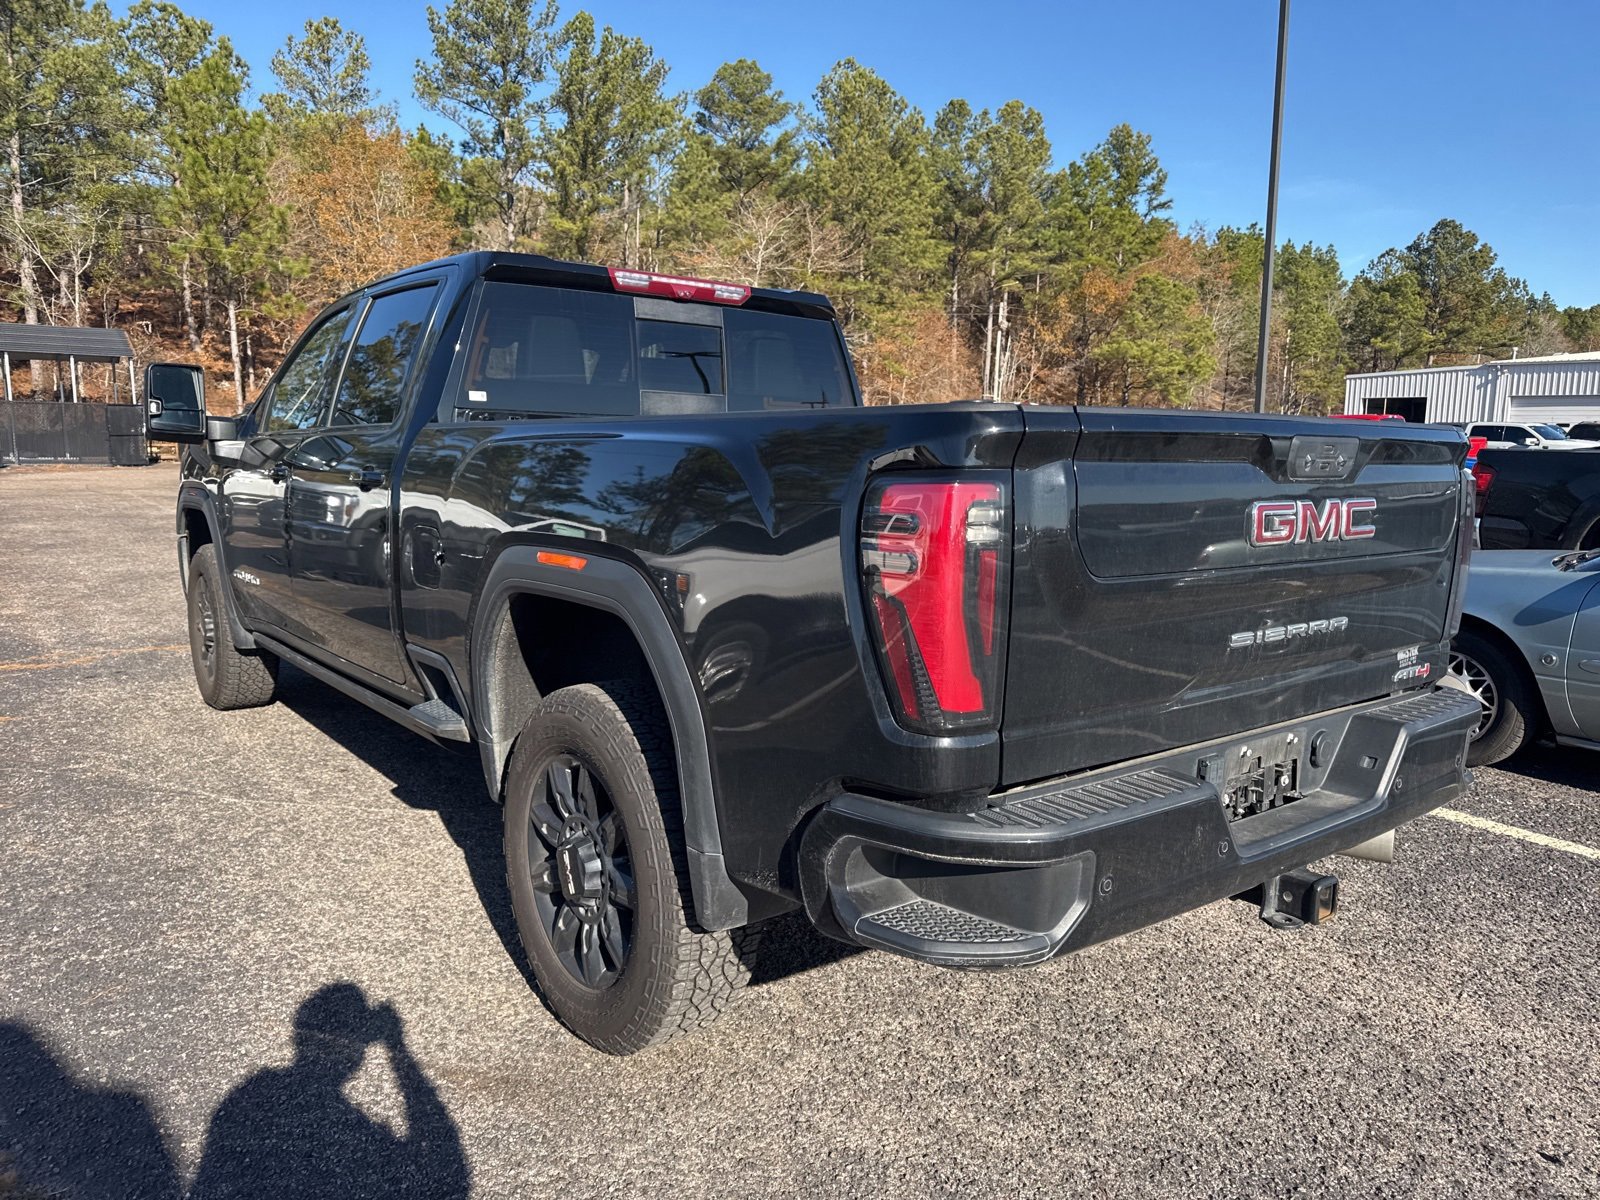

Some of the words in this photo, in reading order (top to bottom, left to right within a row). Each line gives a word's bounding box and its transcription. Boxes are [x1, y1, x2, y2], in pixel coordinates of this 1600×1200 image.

[1248, 498, 1377, 547] GMC
[1229, 616, 1349, 648] SIERRA
[1392, 662, 1431, 682] AT4
